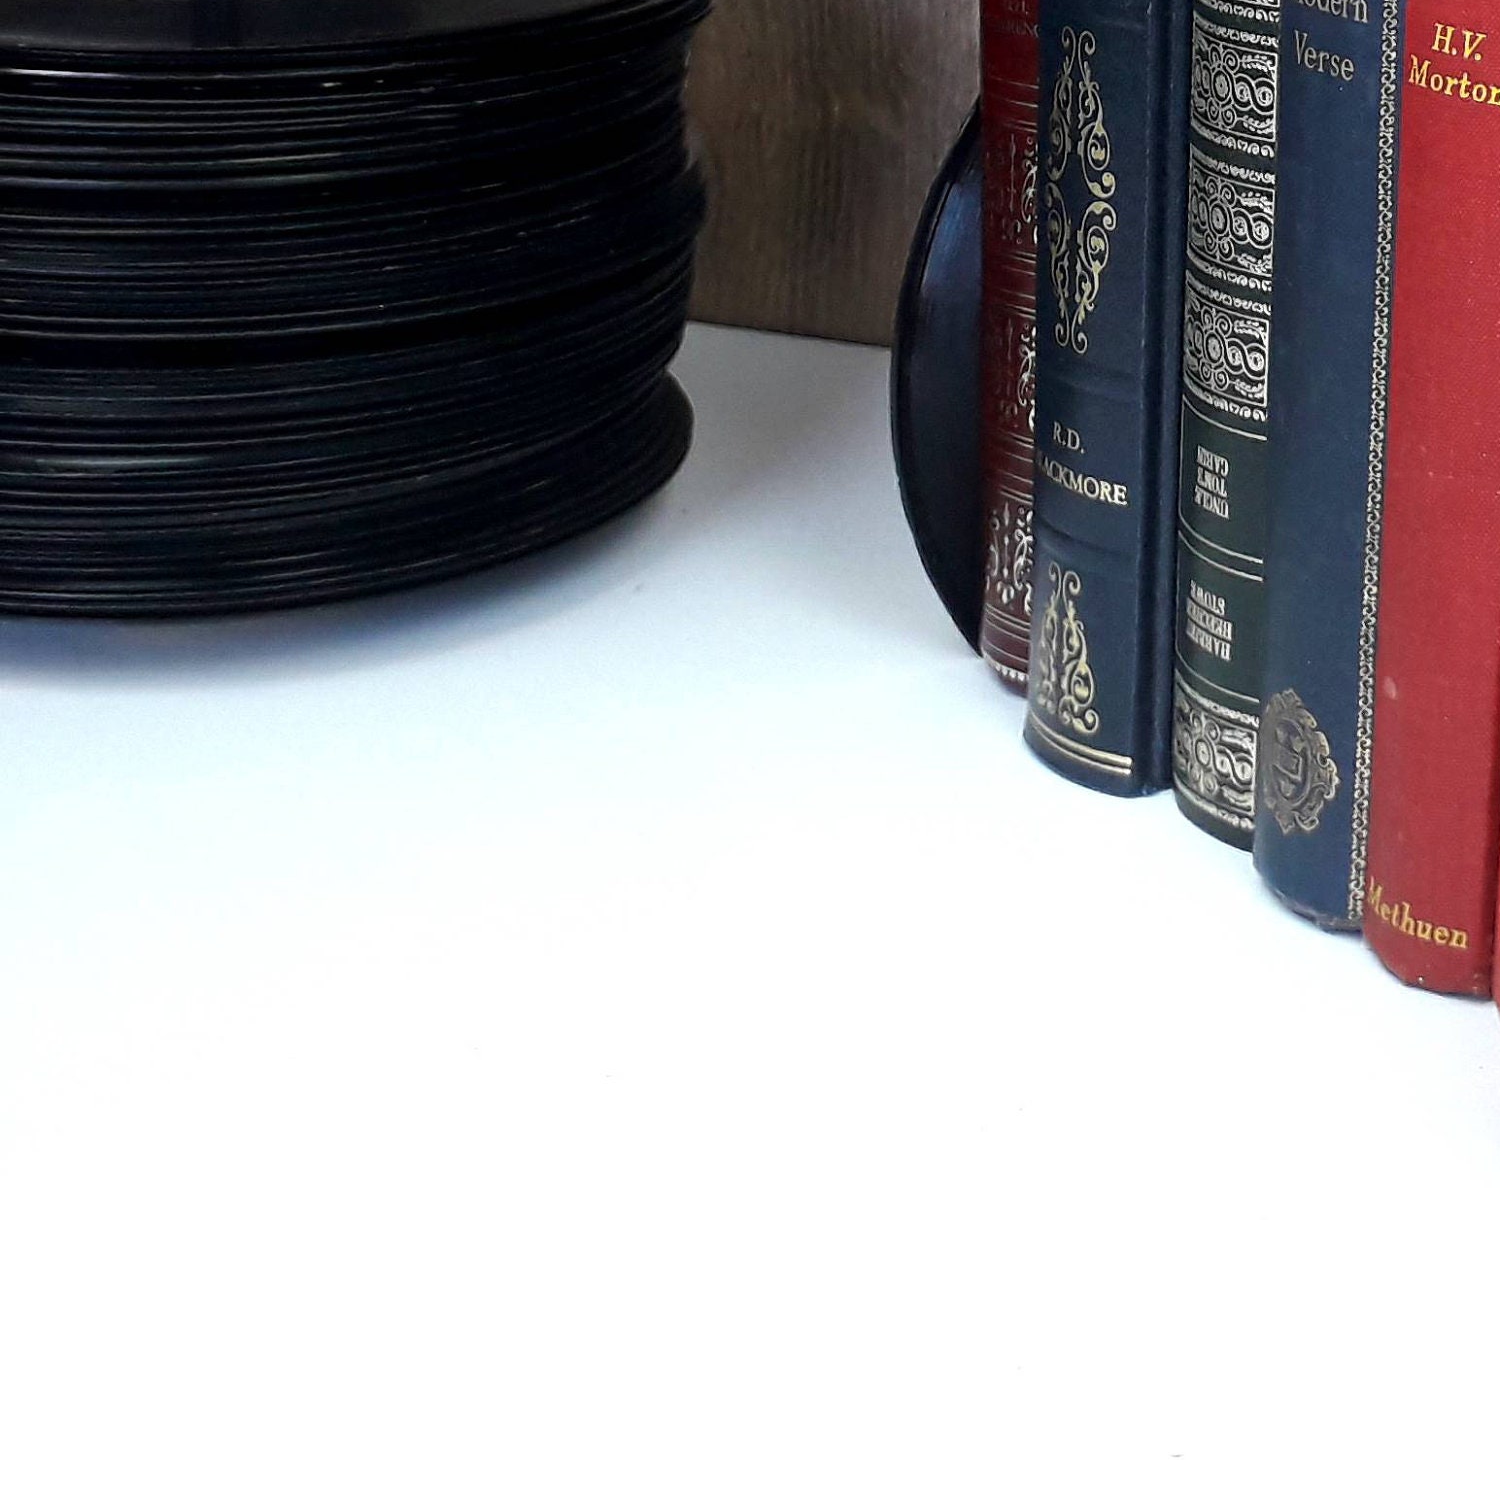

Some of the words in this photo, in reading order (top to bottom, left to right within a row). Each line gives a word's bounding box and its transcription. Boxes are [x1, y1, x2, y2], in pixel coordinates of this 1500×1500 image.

[1294, 30, 1354, 81] Verse
[1053, 421, 1085, 454] R.D.
[1037, 454, 1127, 506] ACKMORE
[1367, 875, 1468, 949] Methuen
